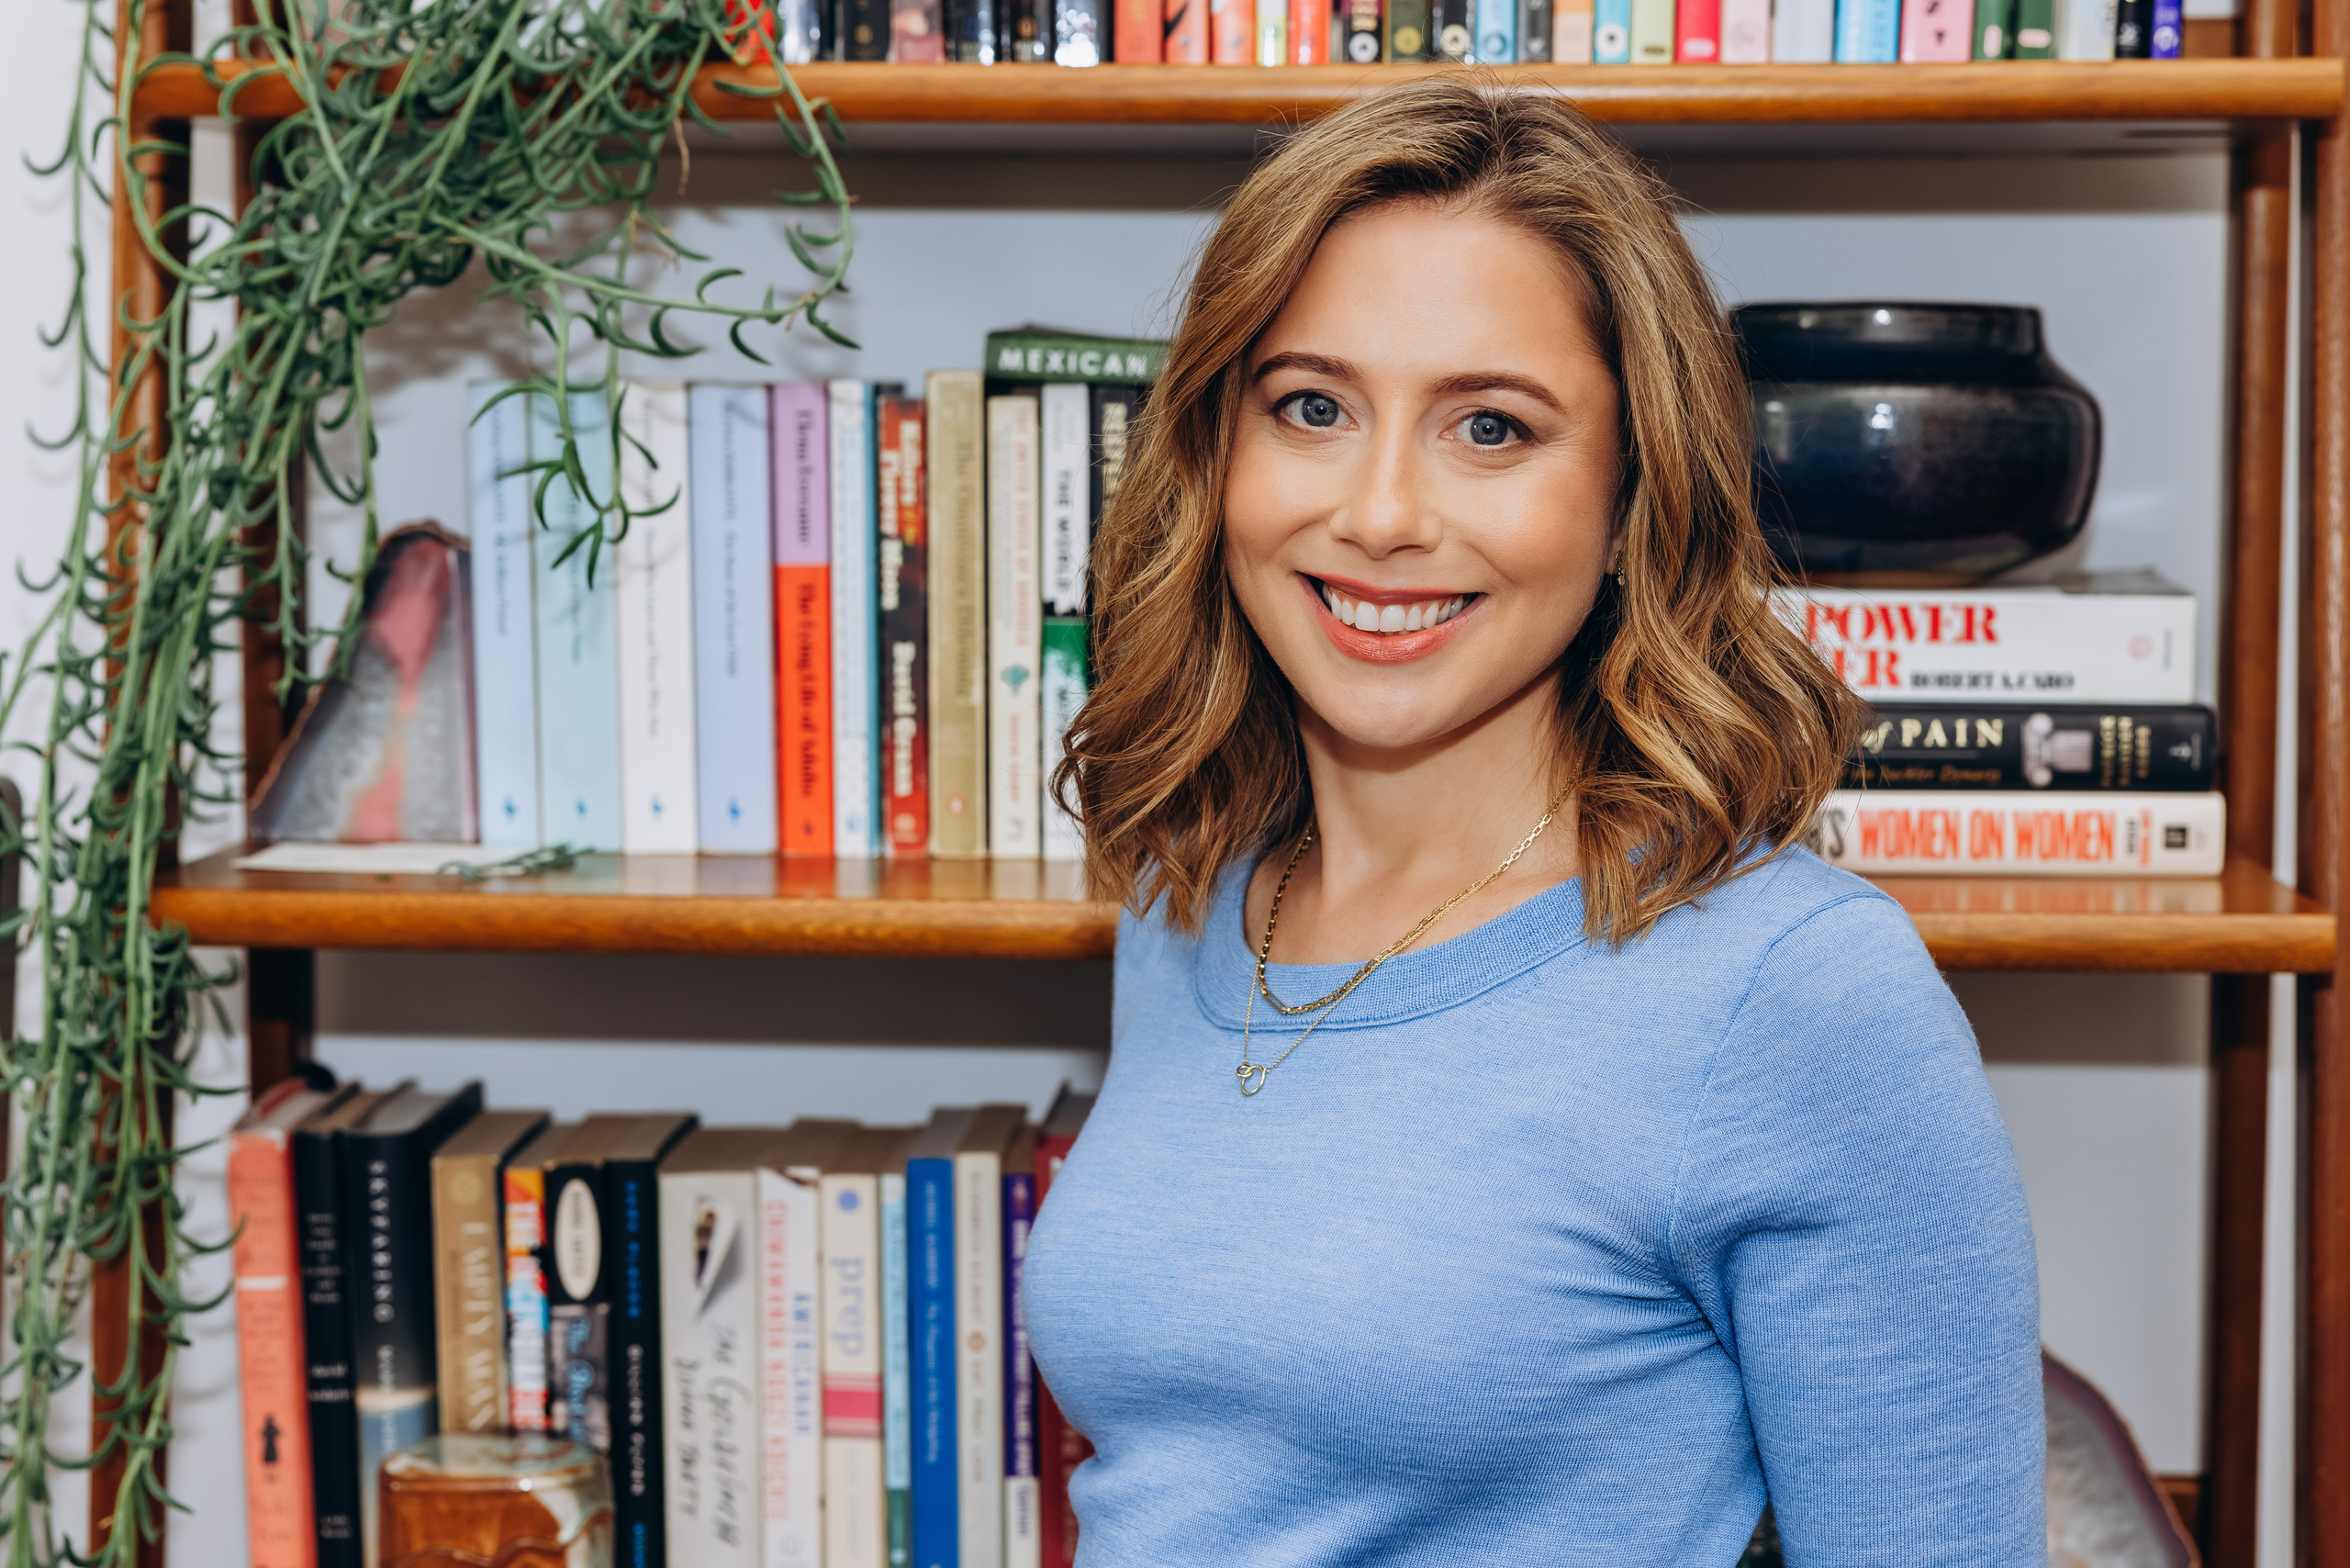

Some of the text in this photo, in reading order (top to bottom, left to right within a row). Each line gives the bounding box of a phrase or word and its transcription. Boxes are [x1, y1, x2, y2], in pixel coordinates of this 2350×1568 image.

[998, 347, 1147, 377] MEXICAN
[1805, 603, 1999, 644] POWER
[893, 641, 916, 714] David
[1901, 718, 2004, 748] PAIN
[1859, 808, 1961, 860] WOMEN
[1969, 809, 2005, 860] ON
[2013, 809, 2116, 861] WOMEN
[367, 1159, 395, 1324] SKYFARING
[832, 1256, 867, 1357] prep
